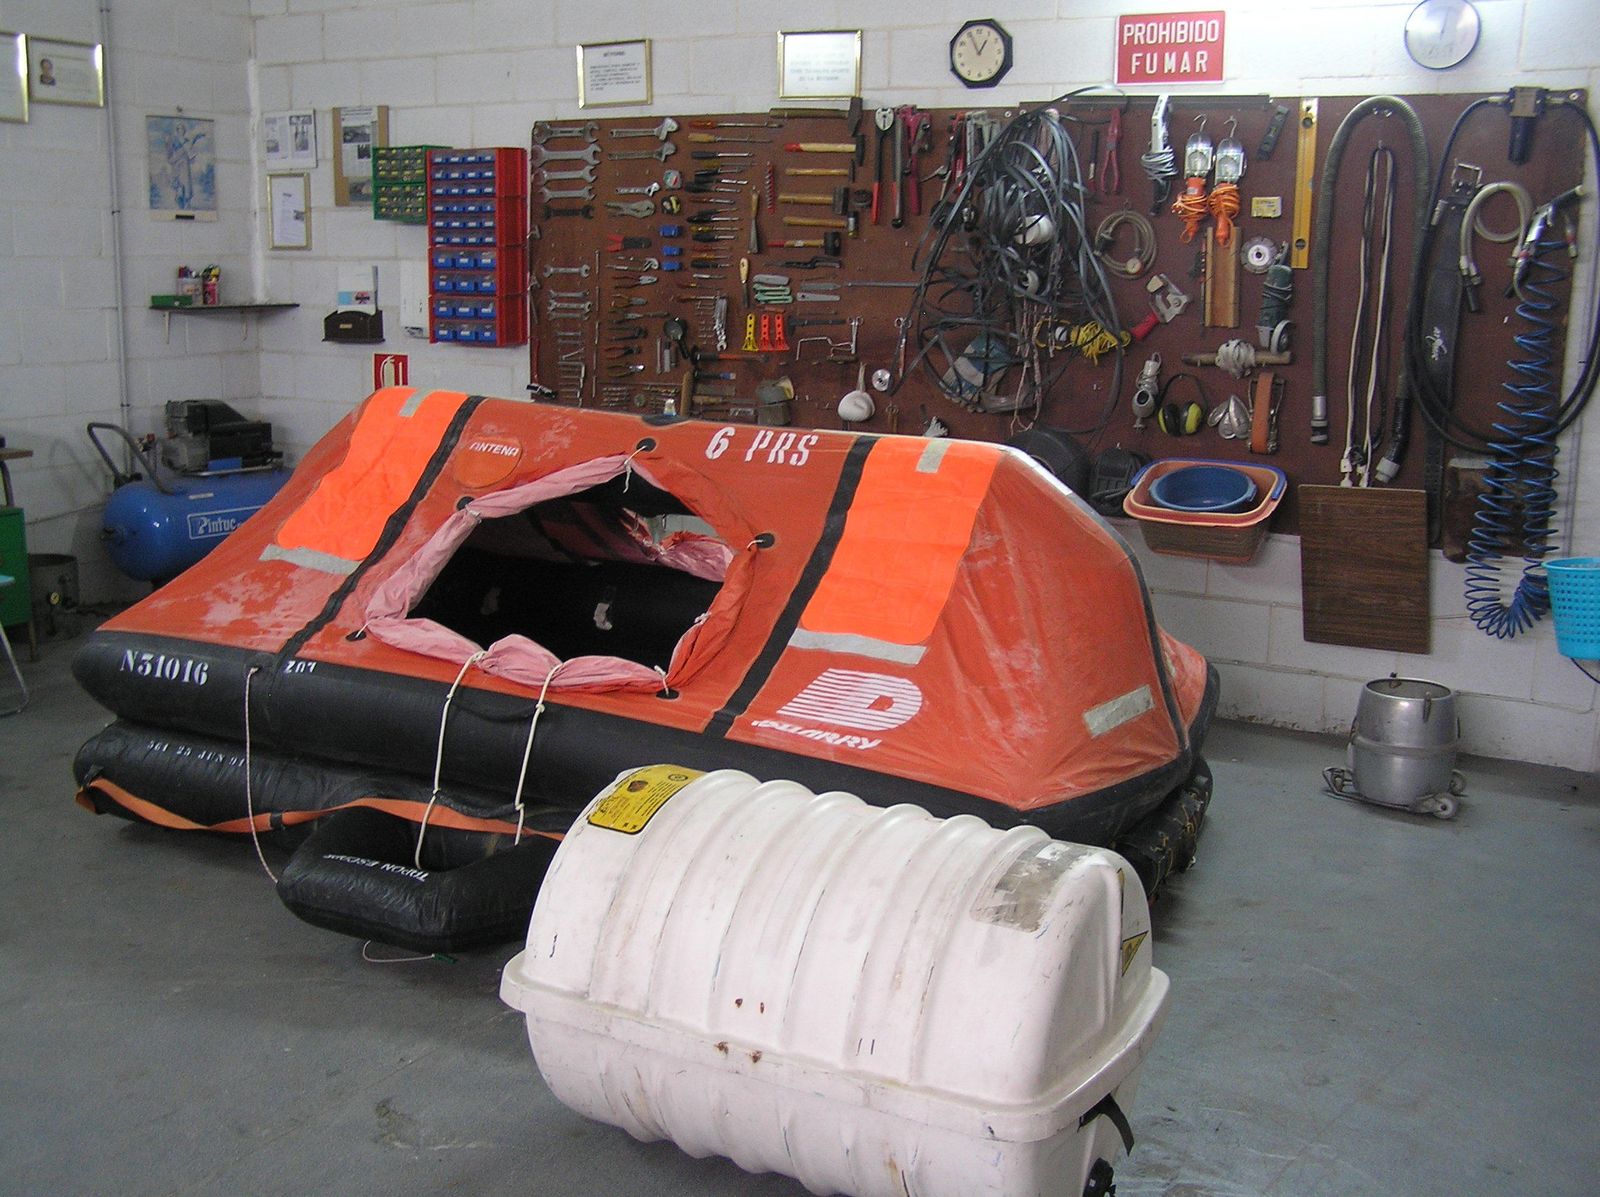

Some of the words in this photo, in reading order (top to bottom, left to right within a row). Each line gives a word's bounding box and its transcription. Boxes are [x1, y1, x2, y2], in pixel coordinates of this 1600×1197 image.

[1123, 20, 1219, 45] PROHIBIDO
[1131, 50, 1208, 74] FUMAR
[469, 442, 520, 457] ANTENA
[705, 426, 736, 460] 6
[744, 429, 819, 467] PRS
[120, 650, 209, 685] N31016
